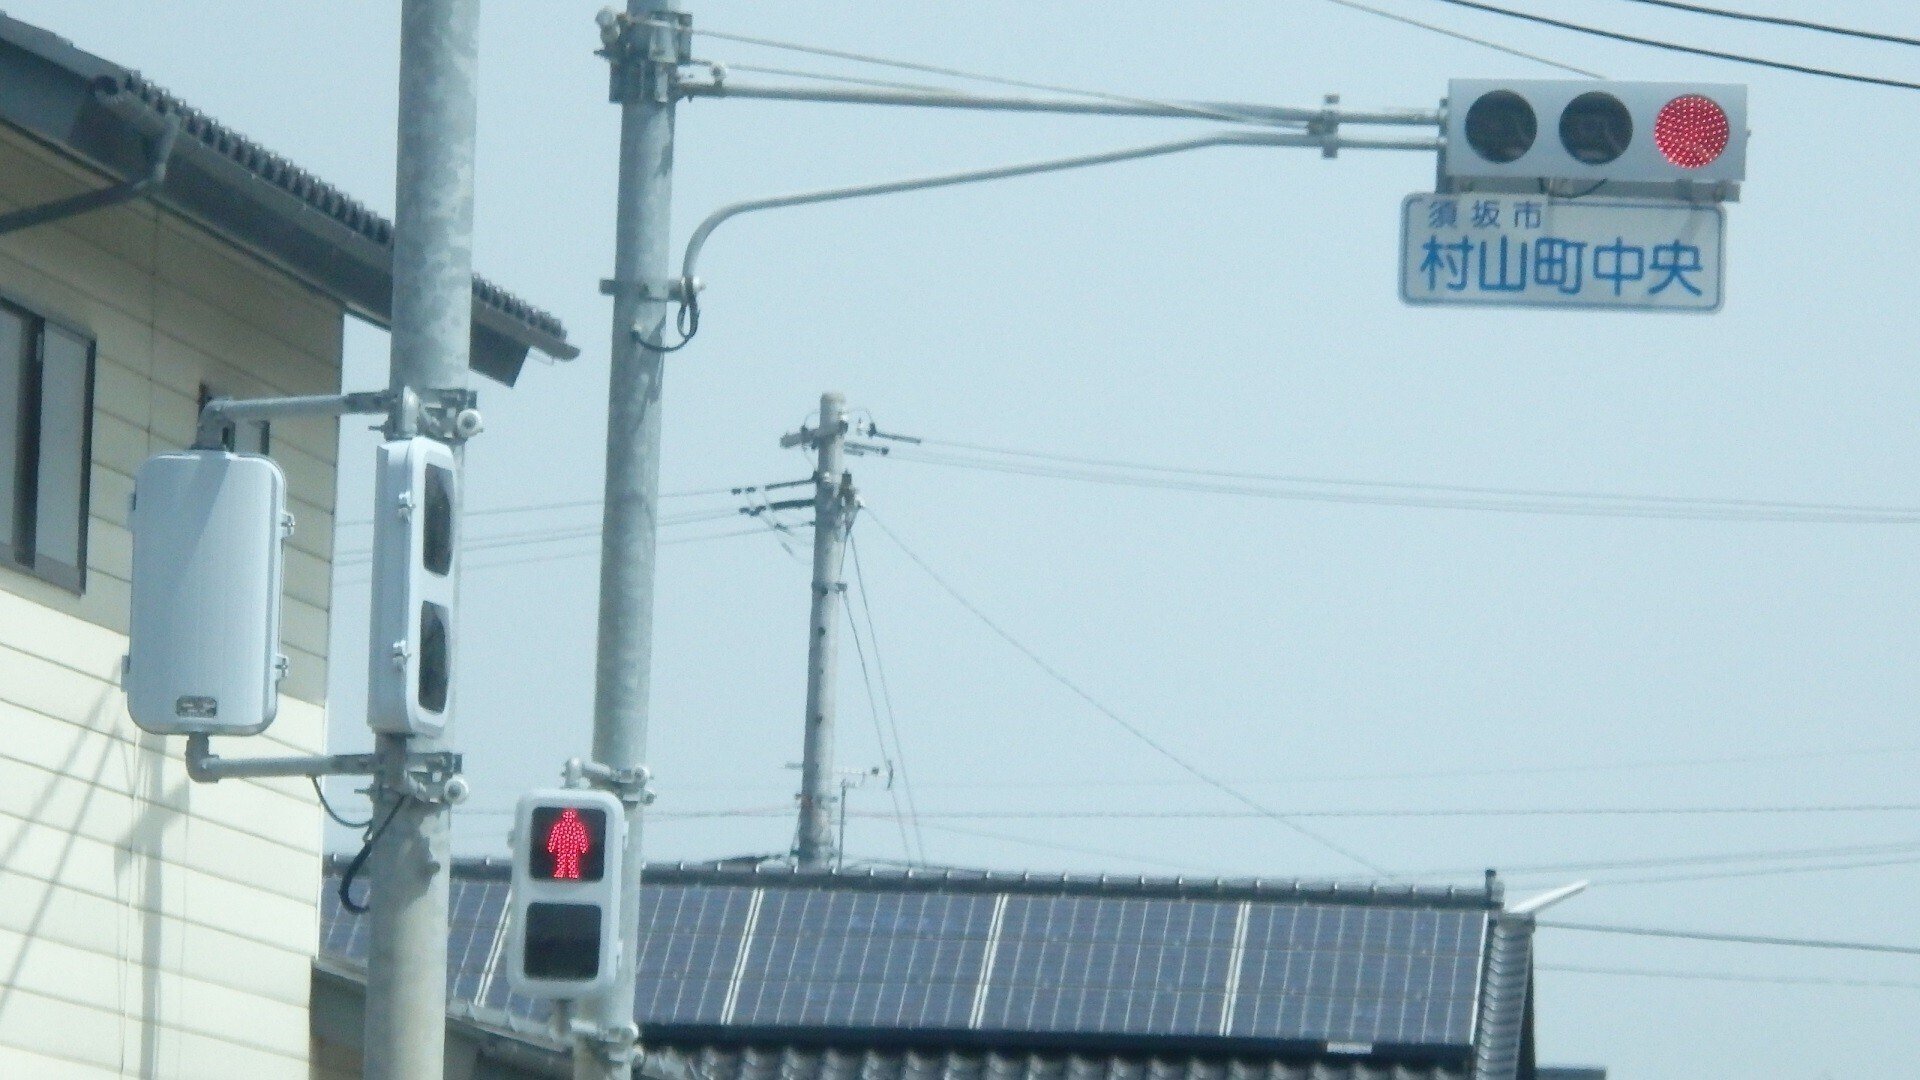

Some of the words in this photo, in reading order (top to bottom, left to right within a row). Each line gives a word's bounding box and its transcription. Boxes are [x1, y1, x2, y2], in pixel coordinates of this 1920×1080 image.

[1428, 200, 1542, 229] 須坂市
[1420, 234, 1703, 296] 村山町中央
